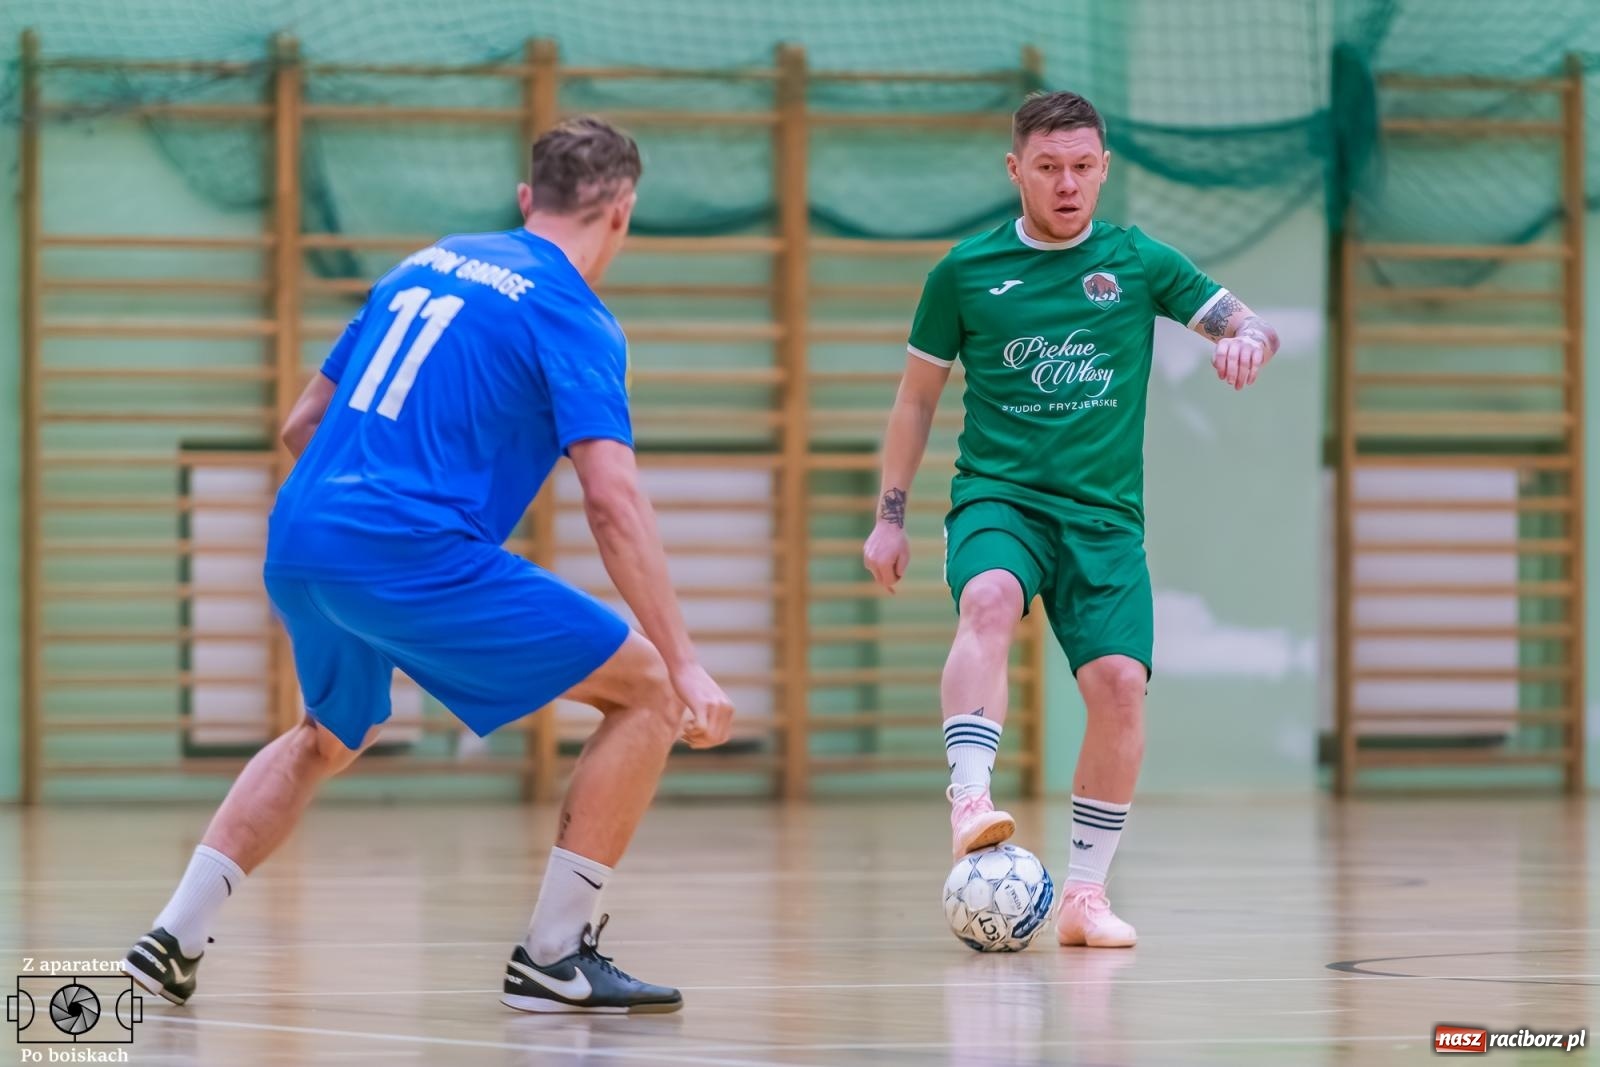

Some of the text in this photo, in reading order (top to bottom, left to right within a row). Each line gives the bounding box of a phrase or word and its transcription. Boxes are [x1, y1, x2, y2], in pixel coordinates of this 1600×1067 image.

[348, 285, 465, 422] 11
[1003, 328, 1097, 370] Piękne
[1031, 353, 1115, 398] Włosy
[1002, 399, 1118, 413] STUDIO FRYZJERSKIE
